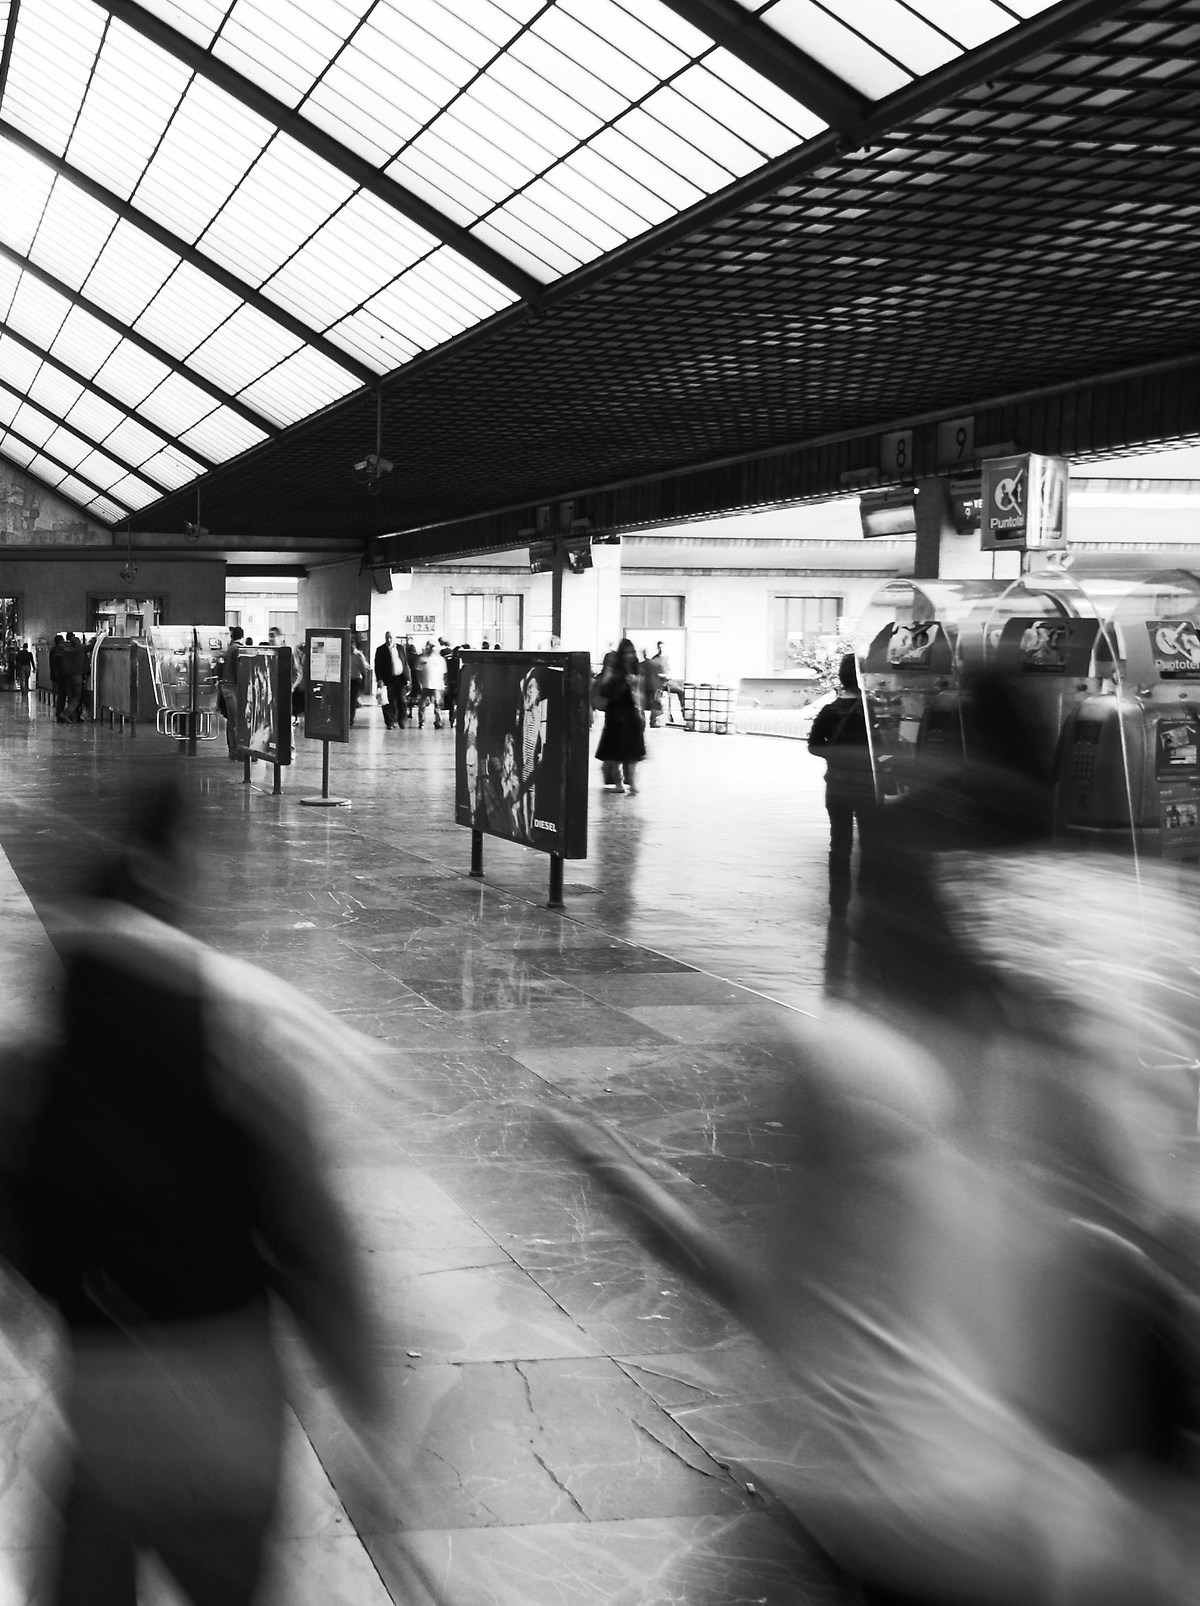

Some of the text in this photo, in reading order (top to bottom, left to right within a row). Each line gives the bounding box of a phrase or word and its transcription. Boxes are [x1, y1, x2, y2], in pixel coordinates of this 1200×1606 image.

[896, 438, 906, 468] 8
[956, 427, 966, 459] 9
[534, 818, 557, 833] DIESEL
